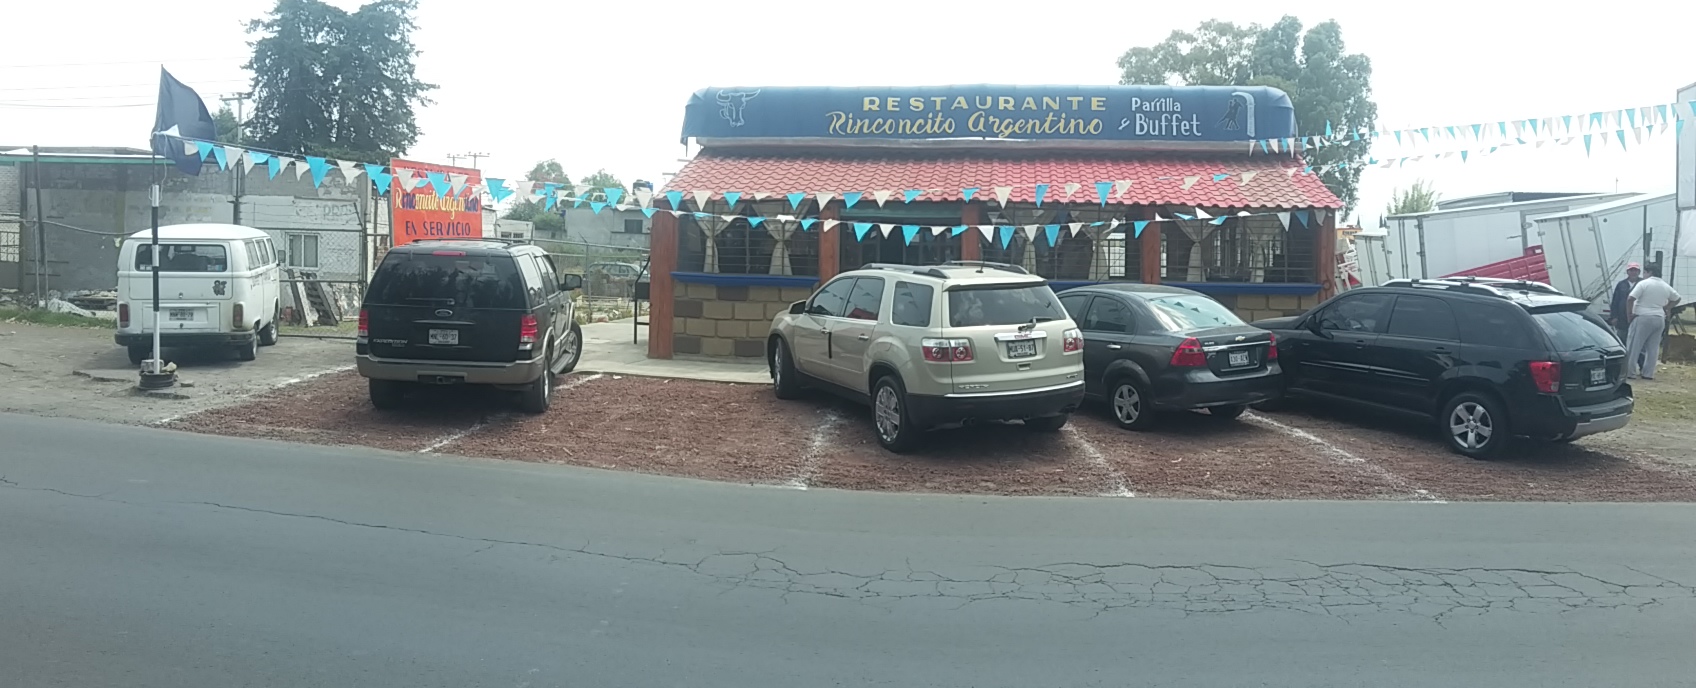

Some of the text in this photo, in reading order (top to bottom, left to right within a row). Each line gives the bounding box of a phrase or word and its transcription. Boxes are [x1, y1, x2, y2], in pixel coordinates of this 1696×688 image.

[862, 96, 1107, 111] RESTAURANTE
[1131, 97, 1181, 112] Parrilla
[825, 110, 1104, 138] Rinconcito Argentino
[1135, 113, 1202, 136] Buffet
[405, 221, 471, 236] EN SERVICIO
